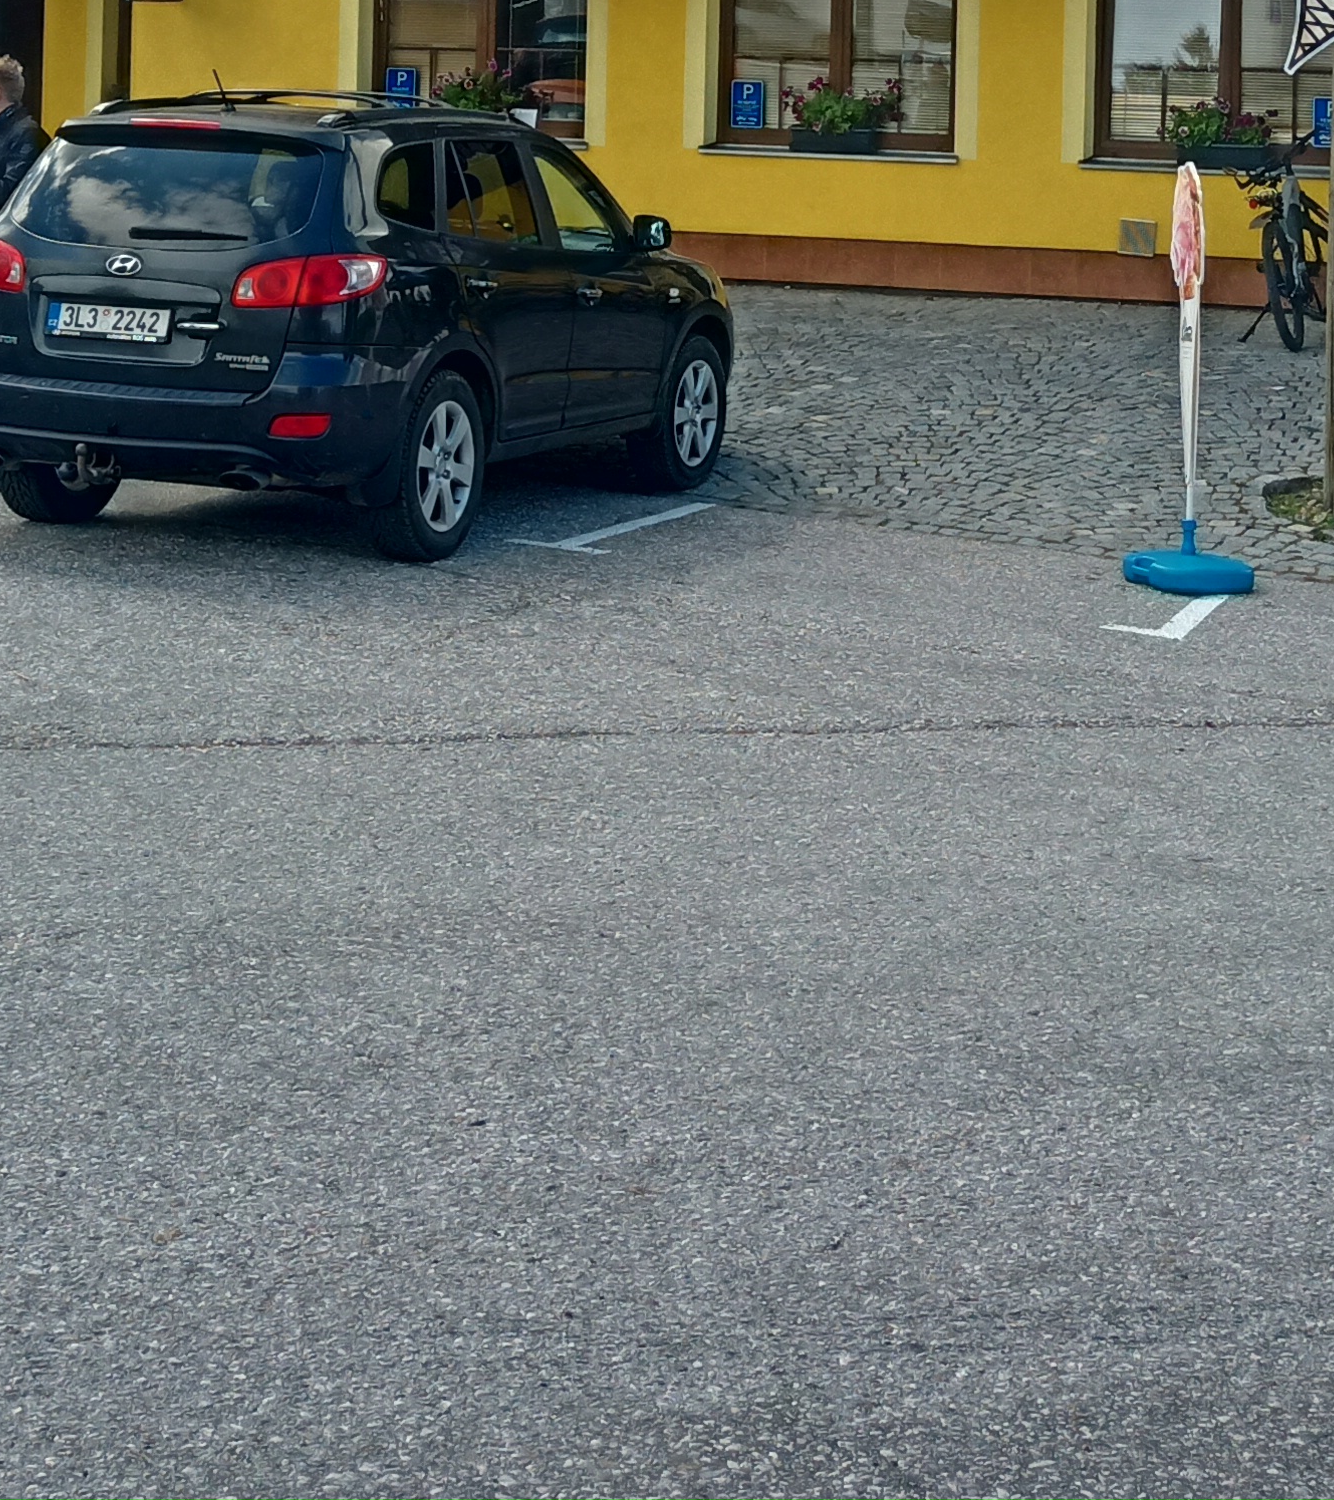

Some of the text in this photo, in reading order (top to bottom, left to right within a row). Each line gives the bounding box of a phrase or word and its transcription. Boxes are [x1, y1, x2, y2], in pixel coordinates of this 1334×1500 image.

[397, 71, 407, 86] P
[743, 84, 754, 99] P
[63, 307, 161, 333] 3L3 2242
